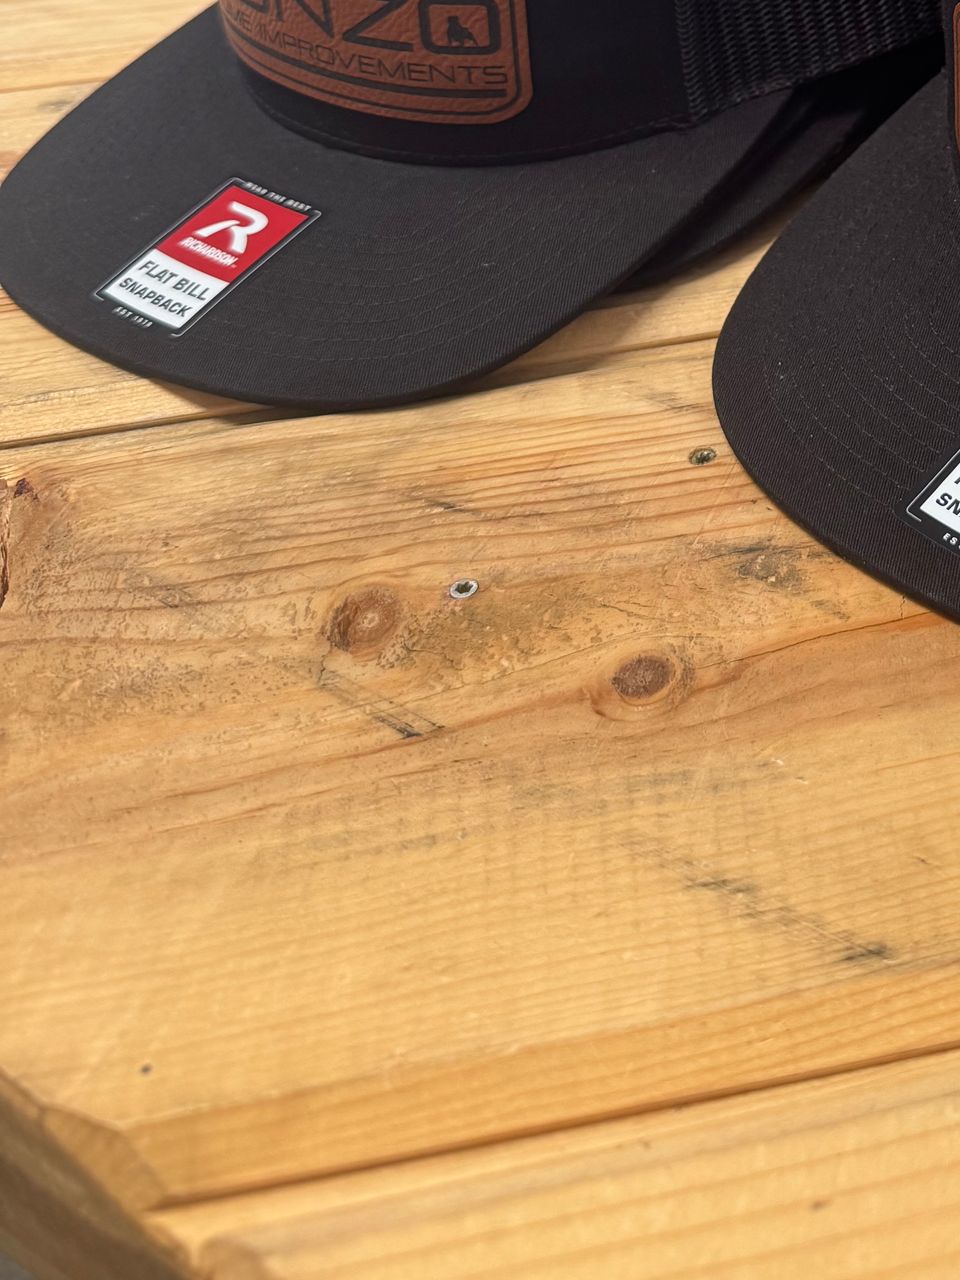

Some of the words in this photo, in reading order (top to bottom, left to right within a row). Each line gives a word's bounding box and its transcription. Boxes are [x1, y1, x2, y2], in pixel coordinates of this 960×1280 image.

[259, 22, 509, 85] IMPROVEMENTS
[177, 236, 239, 268] RICHARDSON
[118, 276, 194, 318] SNAPBACK
[138, 259, 179, 285] FLAT
[173, 277, 211, 302] BILL
